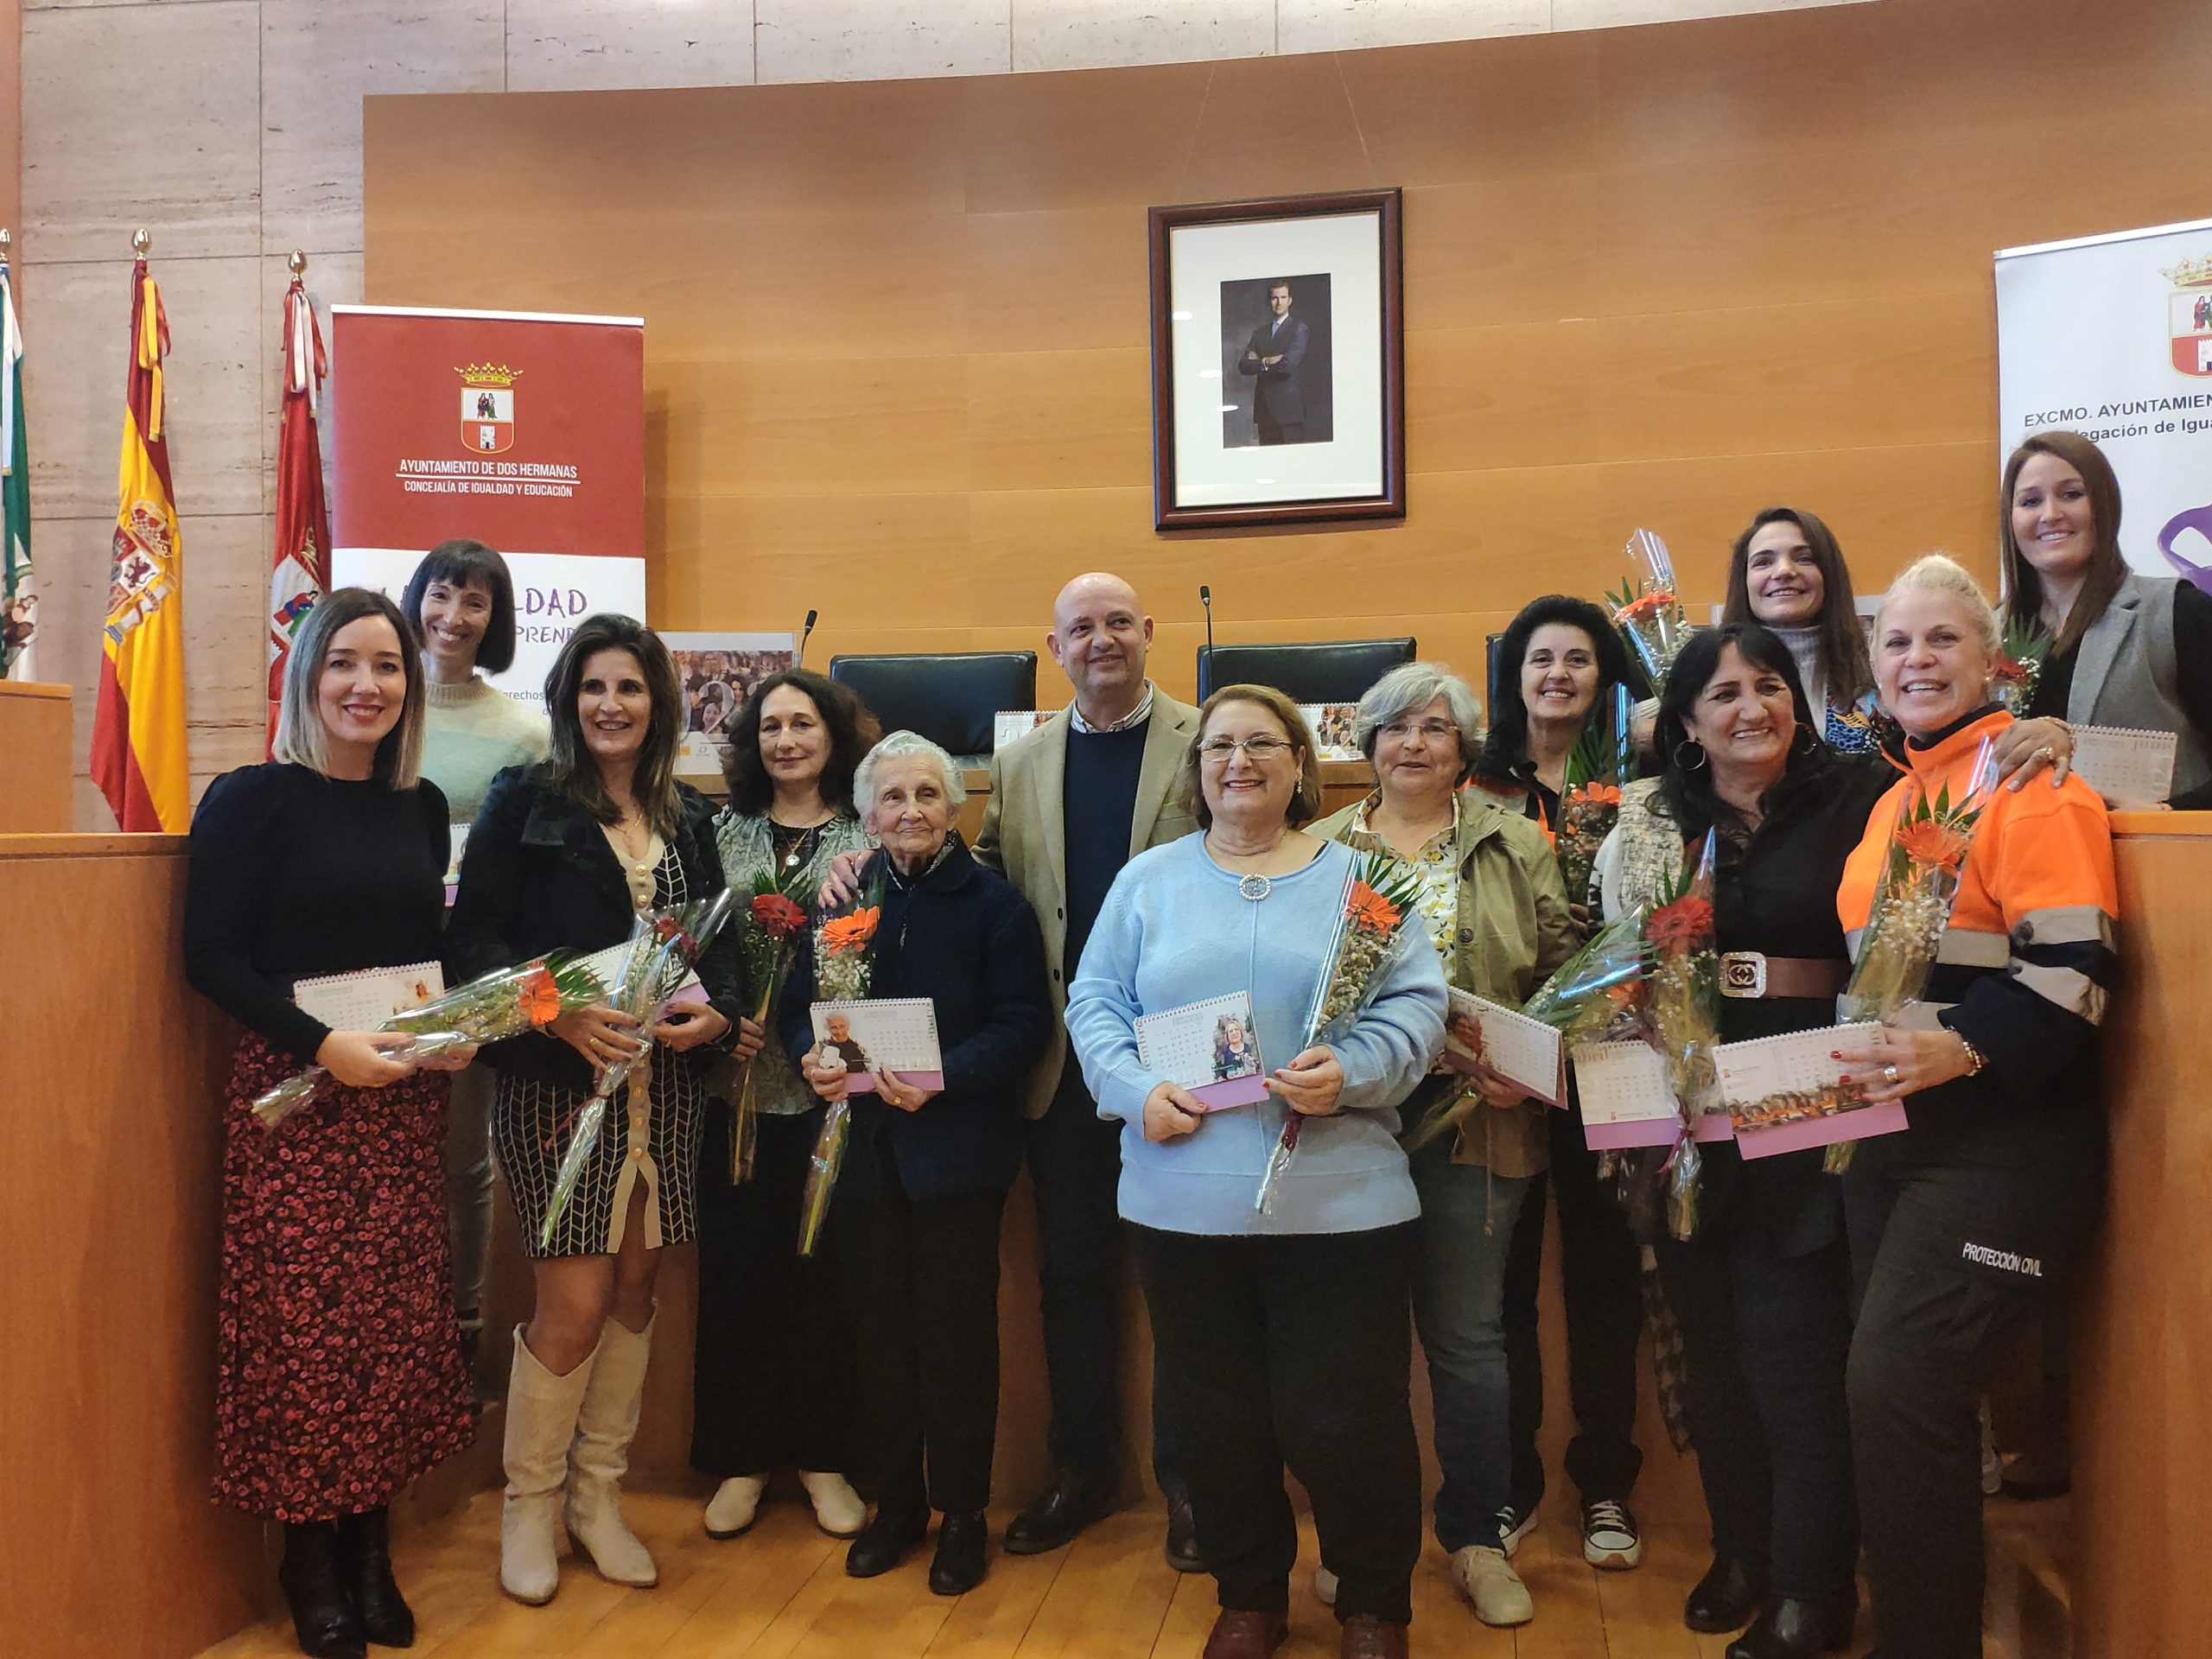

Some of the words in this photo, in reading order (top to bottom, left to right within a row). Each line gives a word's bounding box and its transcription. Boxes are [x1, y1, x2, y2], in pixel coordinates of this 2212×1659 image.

[2024, 407, 2093, 428] EXCMO.
[2154, 420, 2176, 434] de
[2182, 418, 2212, 434] Igu
[399, 459, 479, 475] AYUNTAMIENTO
[481, 462, 494, 475] DE
[498, 462, 518, 476] DOS
[519, 464, 577, 479] HERMANAS
[404, 480, 456, 493] CONCEJALÍA
[459, 482, 469, 493] DE
[472, 483, 514, 495] IGUALDAD
[516, 485, 522, 495] Y
[524, 484, 573, 498] EDUCACIÓN
[515, 588, 588, 619] DAD
[1962, 1243, 2021, 1273] PROTECCIÓN
[2021, 1257, 2043, 1276] CIVIL
